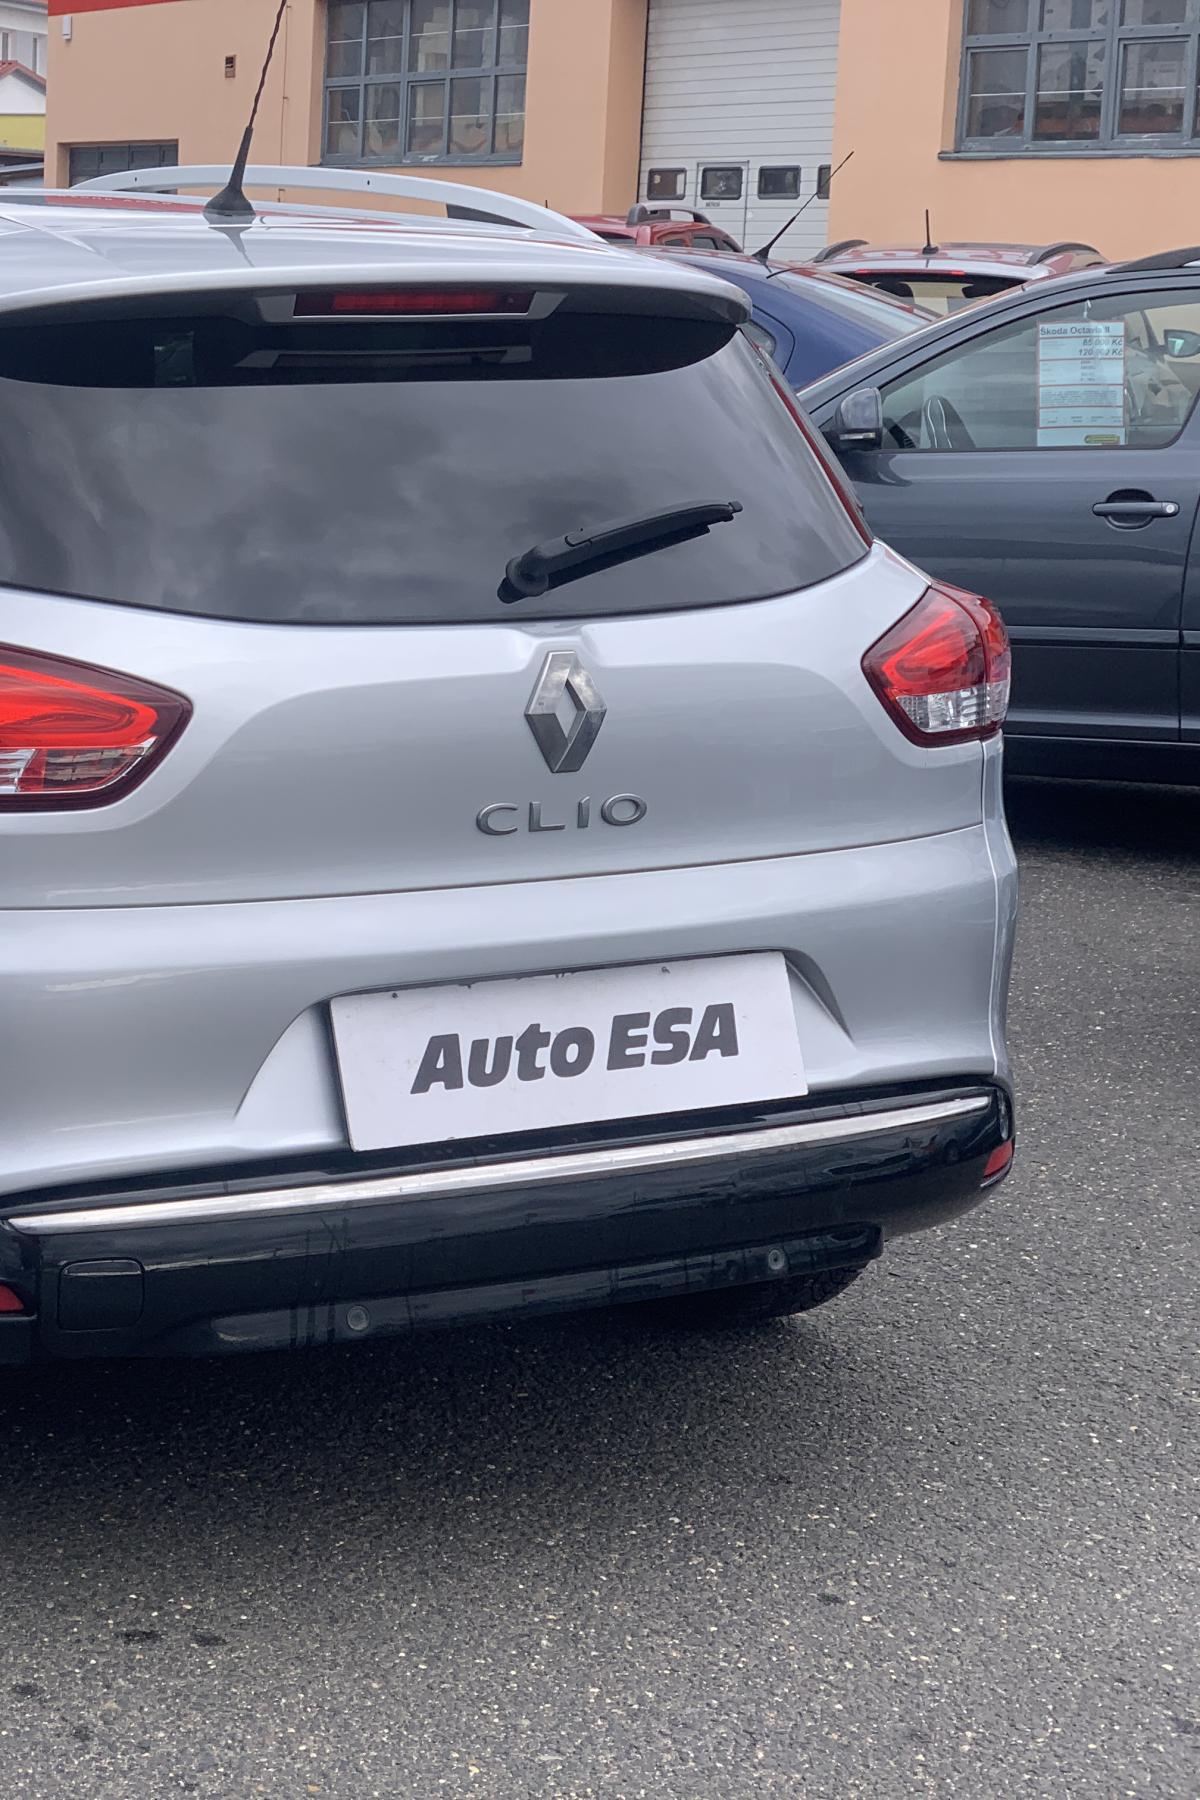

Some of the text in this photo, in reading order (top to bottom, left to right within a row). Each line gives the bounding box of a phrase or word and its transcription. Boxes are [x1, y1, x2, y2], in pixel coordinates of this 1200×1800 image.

[1040, 326, 1068, 336] Škoda
[476, 793, 648, 836] CLIO
[410, 1002, 739, 1095] Auto ESA
